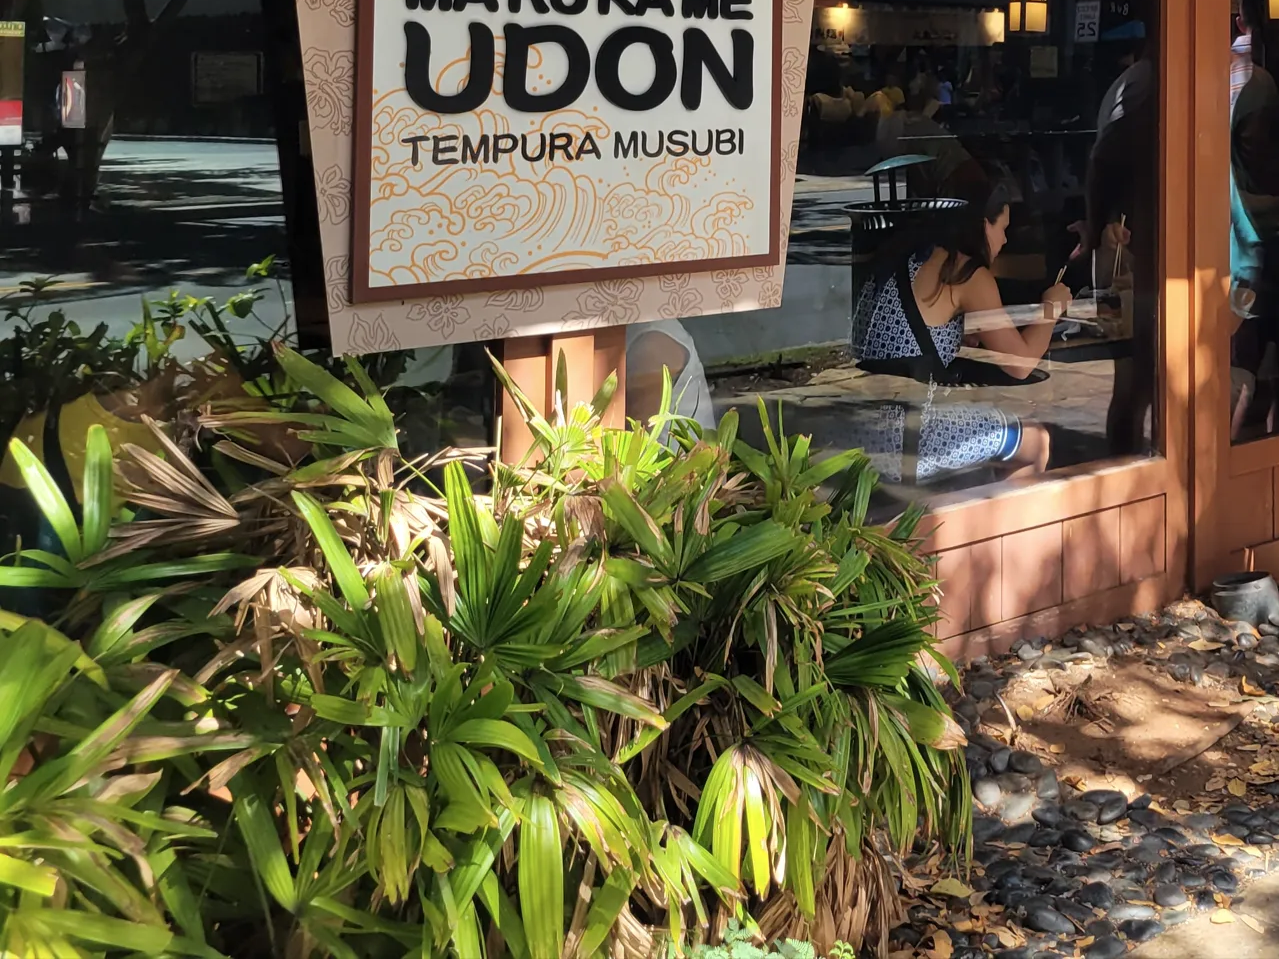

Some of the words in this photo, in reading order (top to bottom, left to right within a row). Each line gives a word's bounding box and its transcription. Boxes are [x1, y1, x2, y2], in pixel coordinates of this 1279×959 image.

[404, 20, 755, 114] UDON
[402, 131, 602, 167] TEMPURA
[613, 128, 745, 159] MUSUBI
